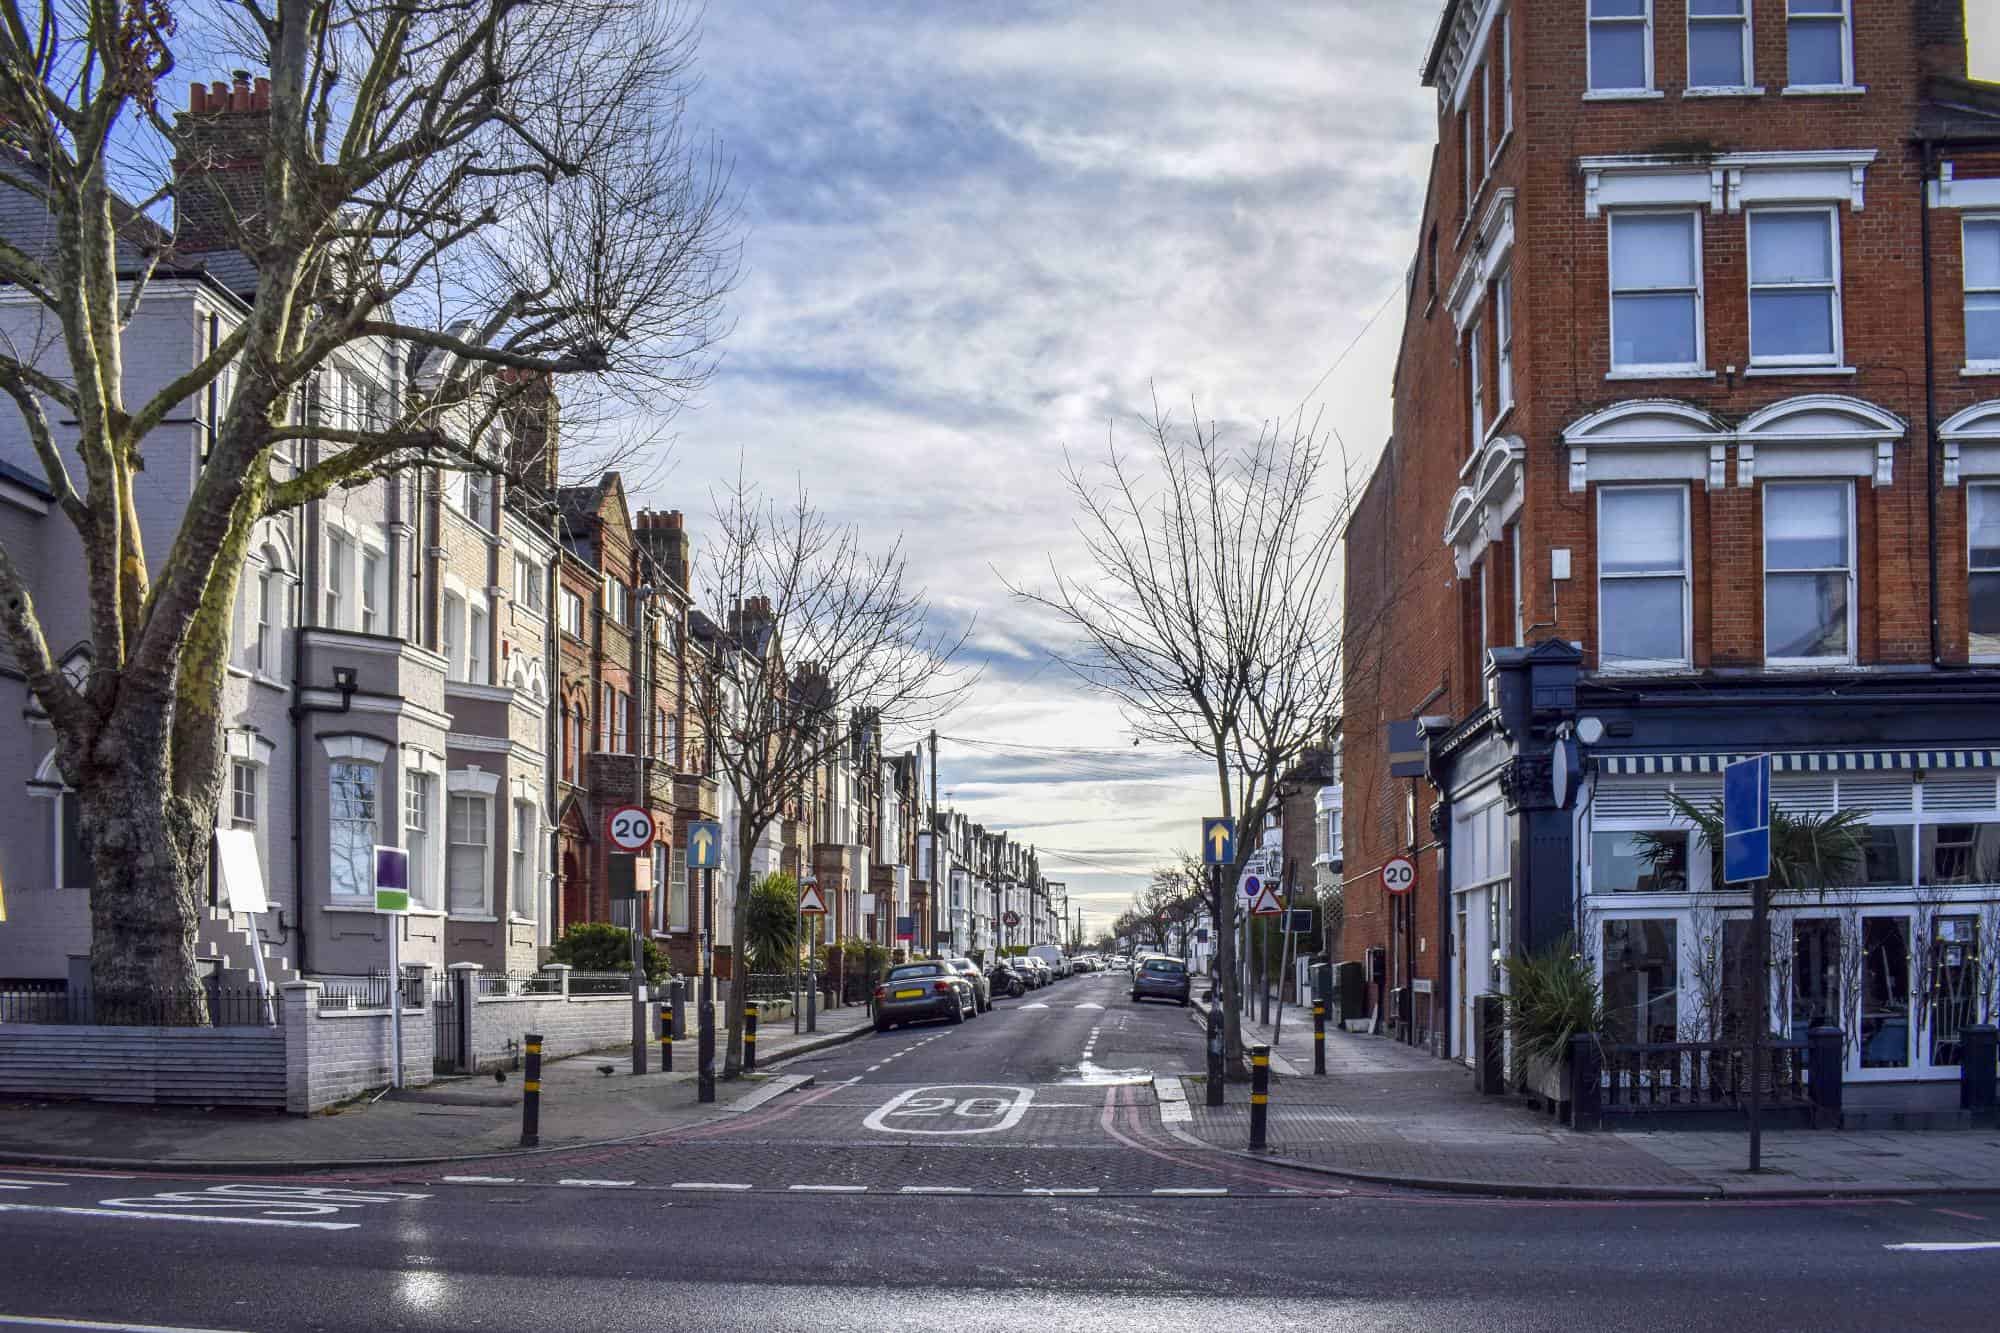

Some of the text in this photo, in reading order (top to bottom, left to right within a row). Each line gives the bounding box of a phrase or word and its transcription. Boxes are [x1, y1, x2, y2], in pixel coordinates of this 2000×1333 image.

[616, 819, 649, 839] 20
[1386, 867, 1412, 883] 20
[890, 1098, 1011, 1117] 20
[98, 1184, 435, 1215] BUS
